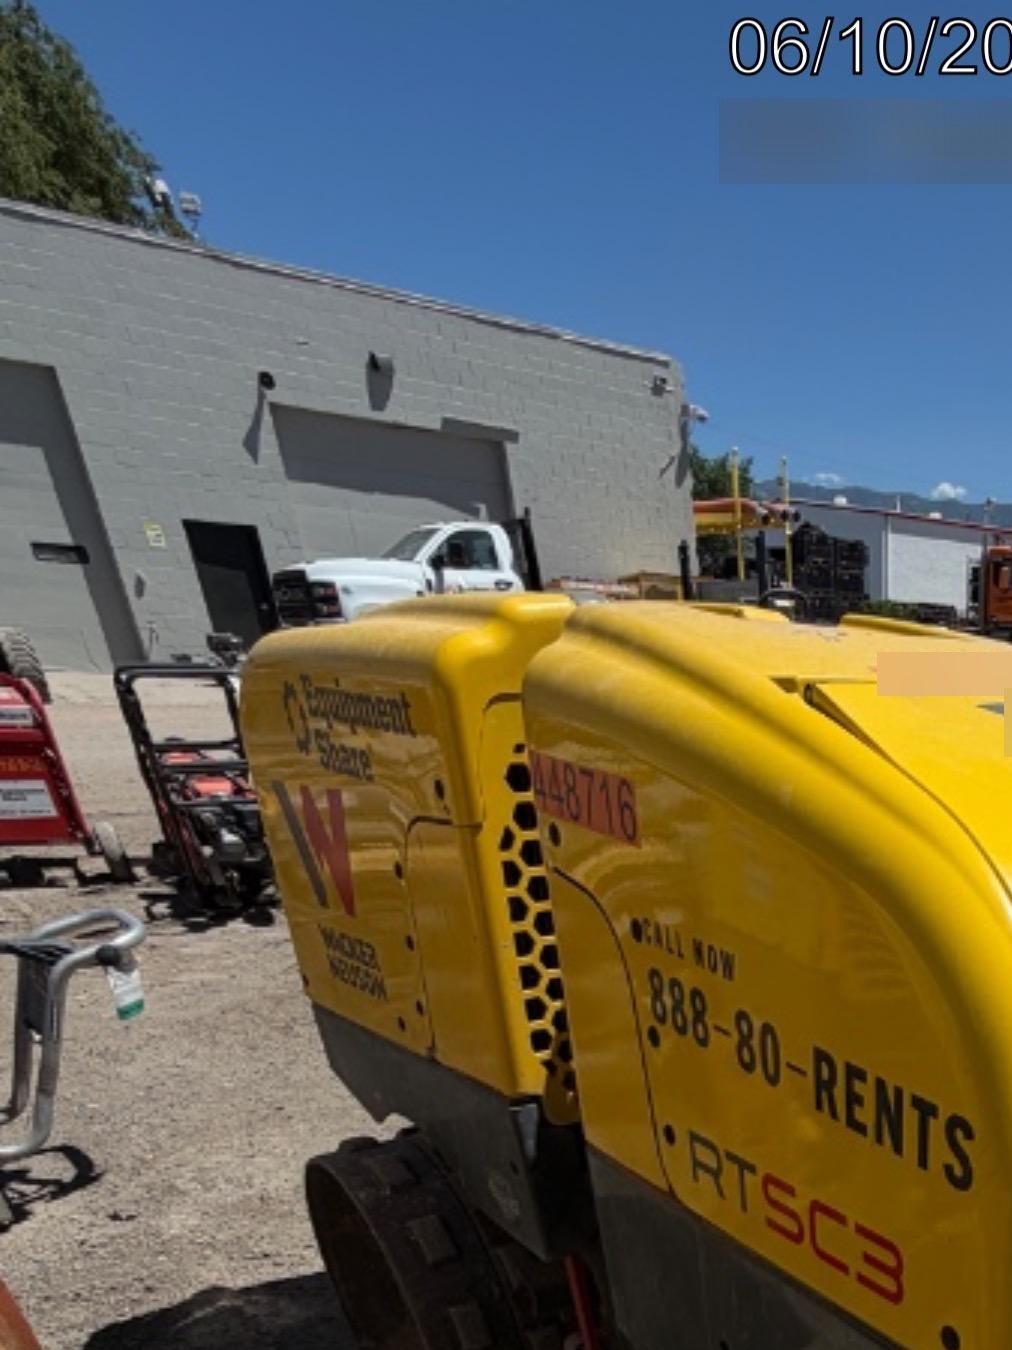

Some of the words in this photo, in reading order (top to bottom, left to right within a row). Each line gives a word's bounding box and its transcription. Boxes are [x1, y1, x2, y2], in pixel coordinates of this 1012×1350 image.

[300, 673, 416, 737] Equipment
[533, 754, 638, 841] 448716
[642, 917, 685, 961] CALL
[692, 937, 736, 982] NOW
[648, 967, 976, 1193] 888-80-RENTS
[688, 1130, 905, 1305] RTSC3
